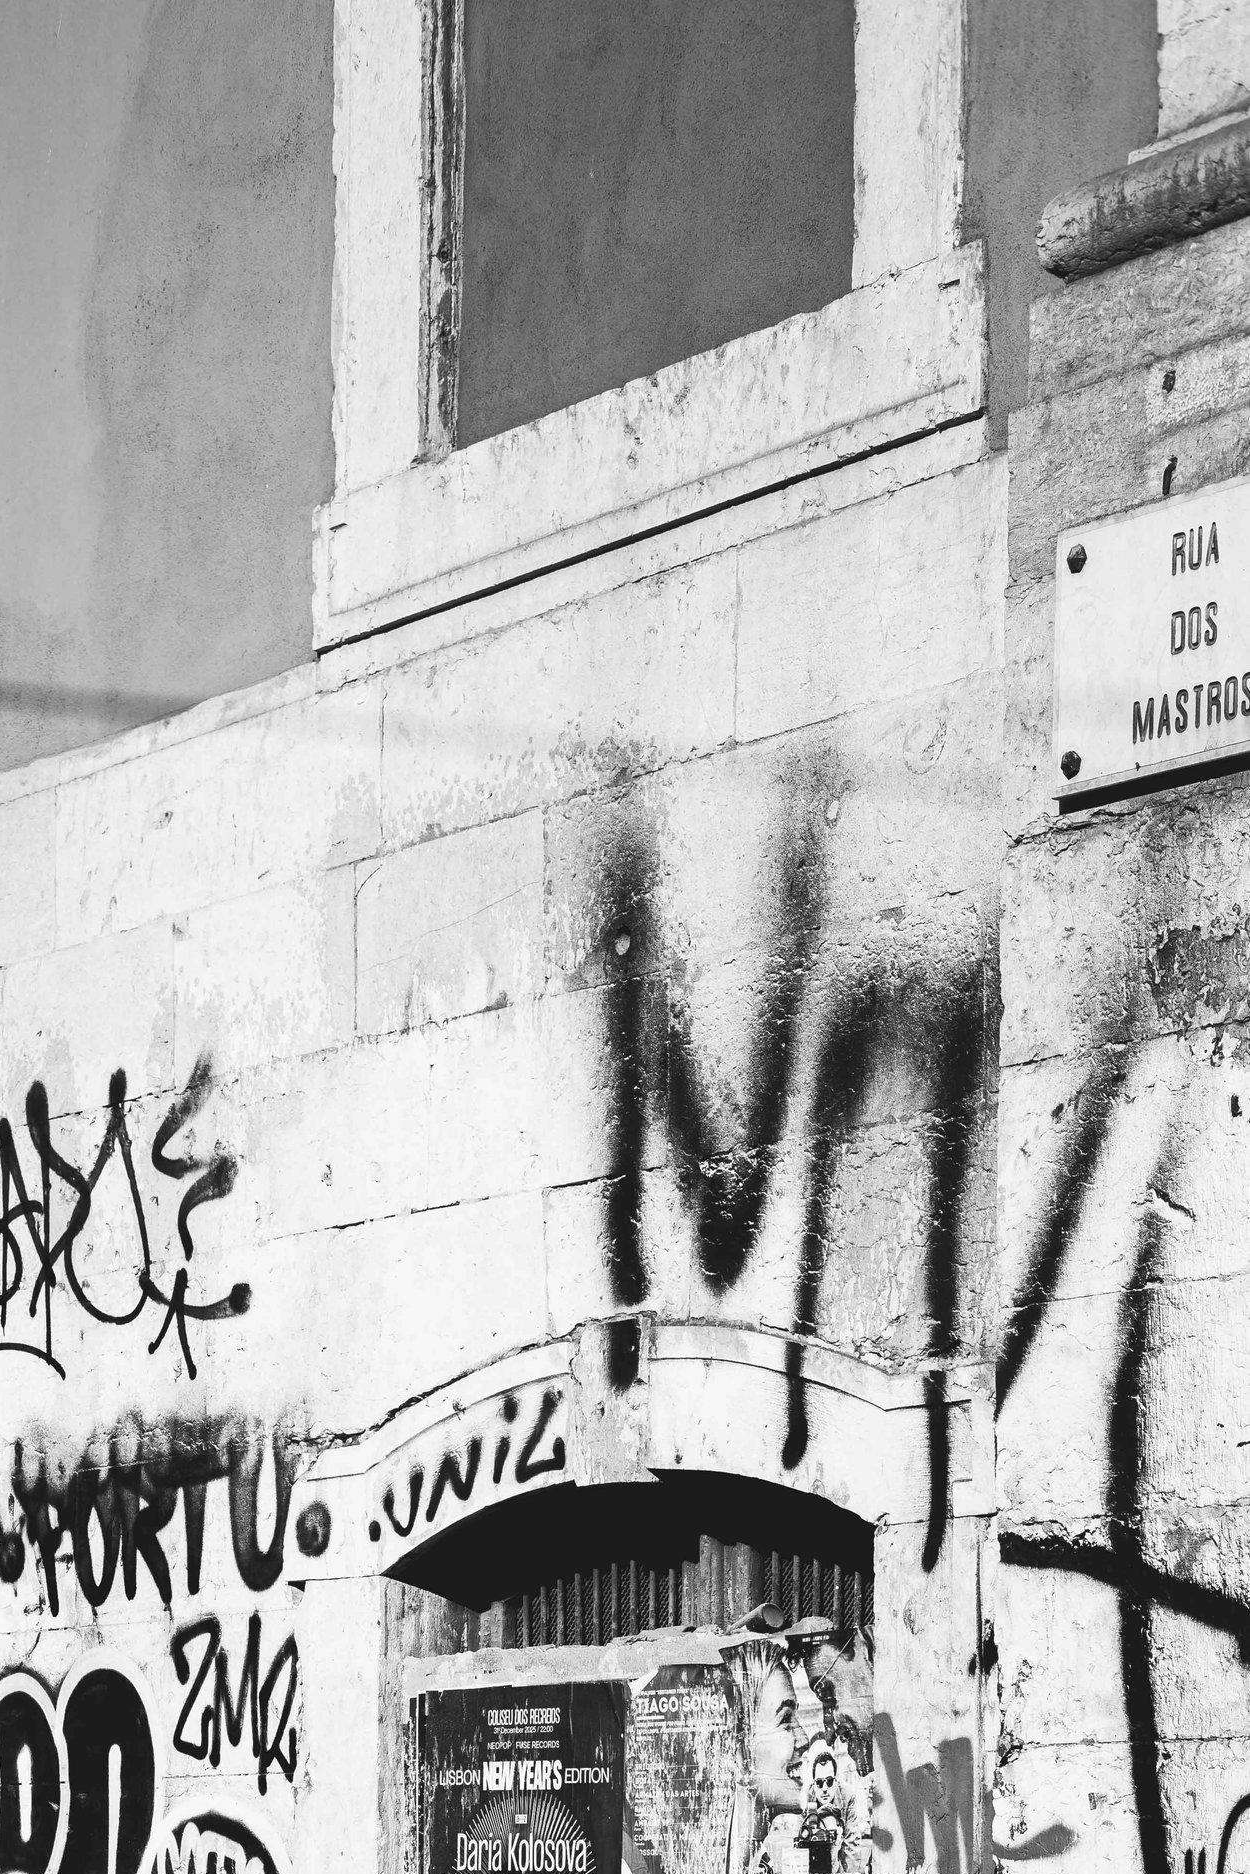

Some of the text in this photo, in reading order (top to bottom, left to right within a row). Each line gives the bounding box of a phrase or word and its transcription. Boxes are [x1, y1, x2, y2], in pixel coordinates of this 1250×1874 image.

[1171, 521, 1220, 577] RUA
[1170, 601, 1219, 656] DOS
[1132, 671, 1250, 745] MASTROS
[487, 1707, 561, 1726] COLISEU DOS RECREIOS
[636, 1694, 729, 1714] TIAGO SOUSA
[531, 1740, 560, 1749] RECORDS
[439, 1759, 610, 1791] LISBON NEW YEAR'S EDITION
[665, 1790, 679, 1798] DAS
[680, 1789, 700, 1798] ARTES
[456, 1832, 588, 1872] Daria Kolosova
